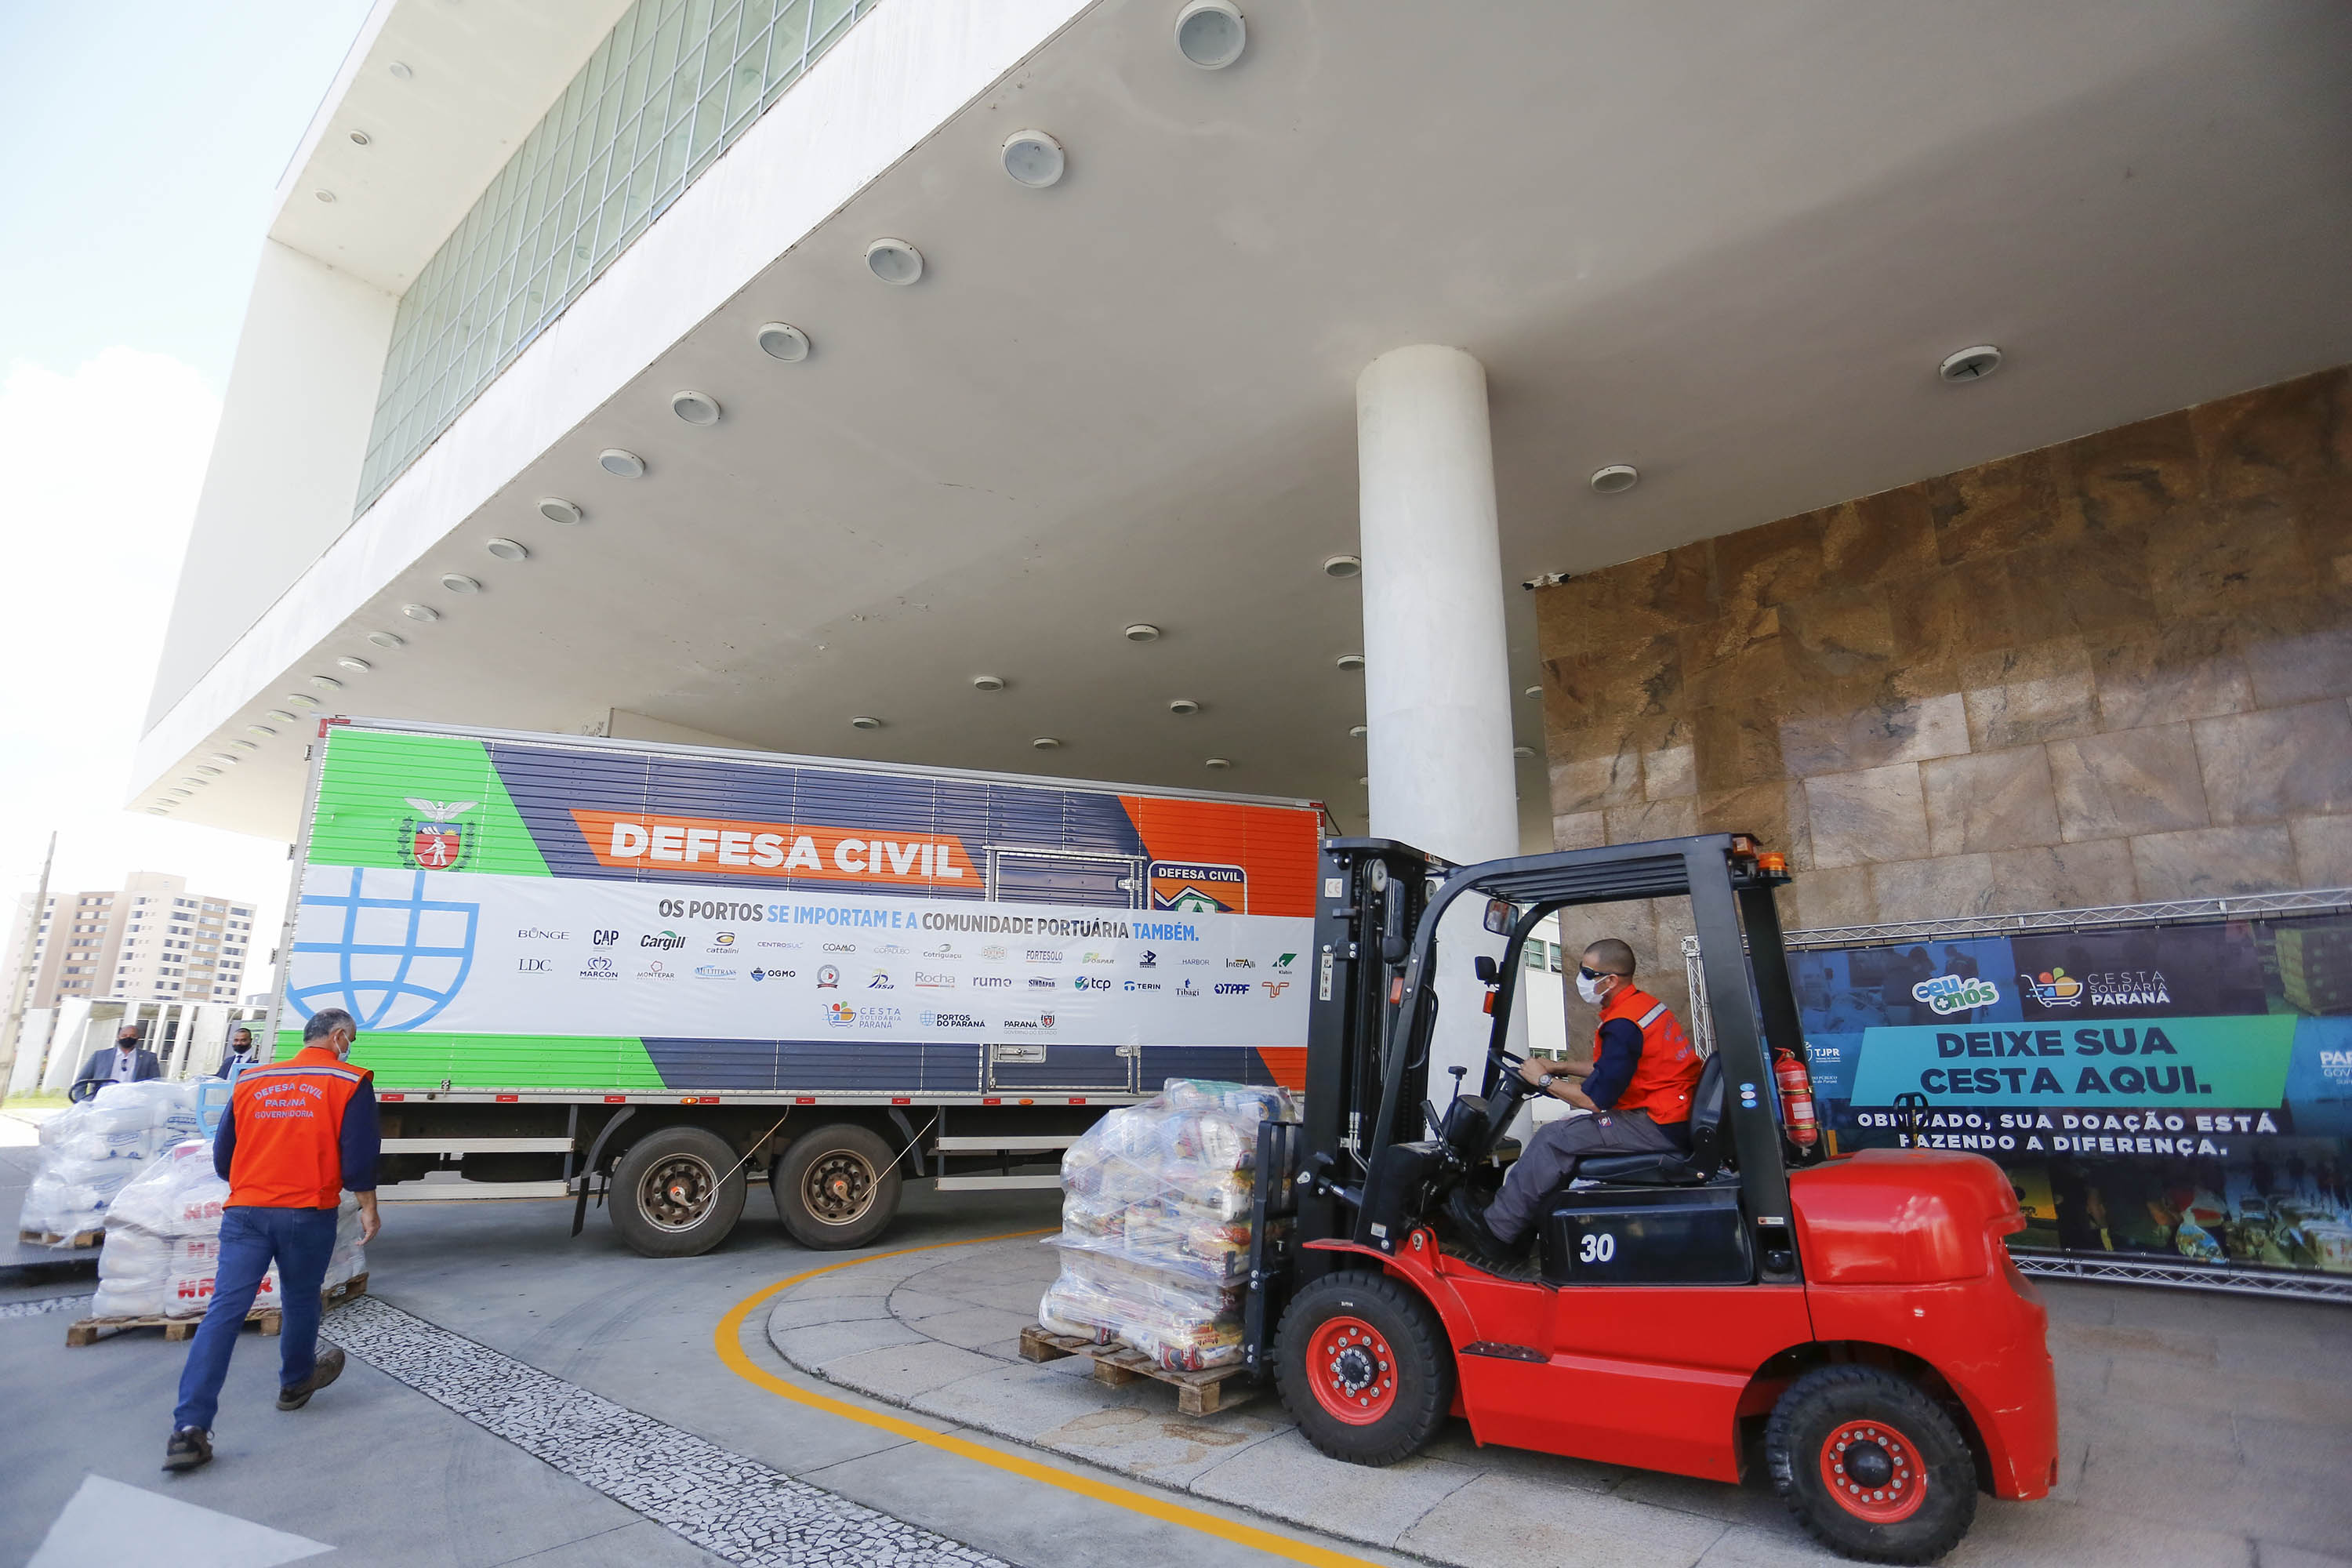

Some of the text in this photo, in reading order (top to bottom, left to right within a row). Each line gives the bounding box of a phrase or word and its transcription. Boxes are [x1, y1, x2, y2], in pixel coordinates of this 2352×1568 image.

[609, 822, 964, 879] DEFESA CIVIL
[1158, 867, 1241, 882] DEFESA CIVIL
[659, 898, 1200, 942] OS PORTOS SE IMPORTAM E A COMUNIDADE PORTUÁRIA TAMBÉM.
[593, 929, 619, 946] CAP
[640, 934, 687, 951] Cargill
[822, 943, 856, 953] COAMO
[1025, 950, 1063, 960] FORTESOLO
[915, 971, 955, 984] Rocha
[973, 976, 1012, 988] rumo
[1091, 977, 1111, 992] tcp
[2087, 970, 2165, 985] CESTA
[1176, 988, 1200, 997] Tibagi
[1224, 984, 1250, 995] TPPF
[2089, 982, 2168, 994] SOLIDÁRIA
[2091, 989, 2171, 1006] PARANÁ
[859, 1007, 901, 1015] CESTA
[858, 1020, 892, 1029] PARANÁ
[951, 1018, 985, 1028] PARANÁ
[1004, 1019, 1037, 1028] PARANÁ
[1935, 1026, 2178, 1058] DEIXE SUA
[1814, 1047, 1840, 1057] TJPR
[1919, 1065, 2212, 1095] CESTA AQUI.
[253, 1082, 324, 1101] DEFESA CIVIL
[1999, 1113, 2053, 1129] SUA
[2062, 1110, 2184, 1133] DOAÇÃO
[2195, 1111, 2278, 1134] ESTÁ
[2027, 1136, 2044, 1150] A
[2053, 1136, 2228, 1156] DIFERENÇA.
[1580, 1233, 1614, 1263] 30
